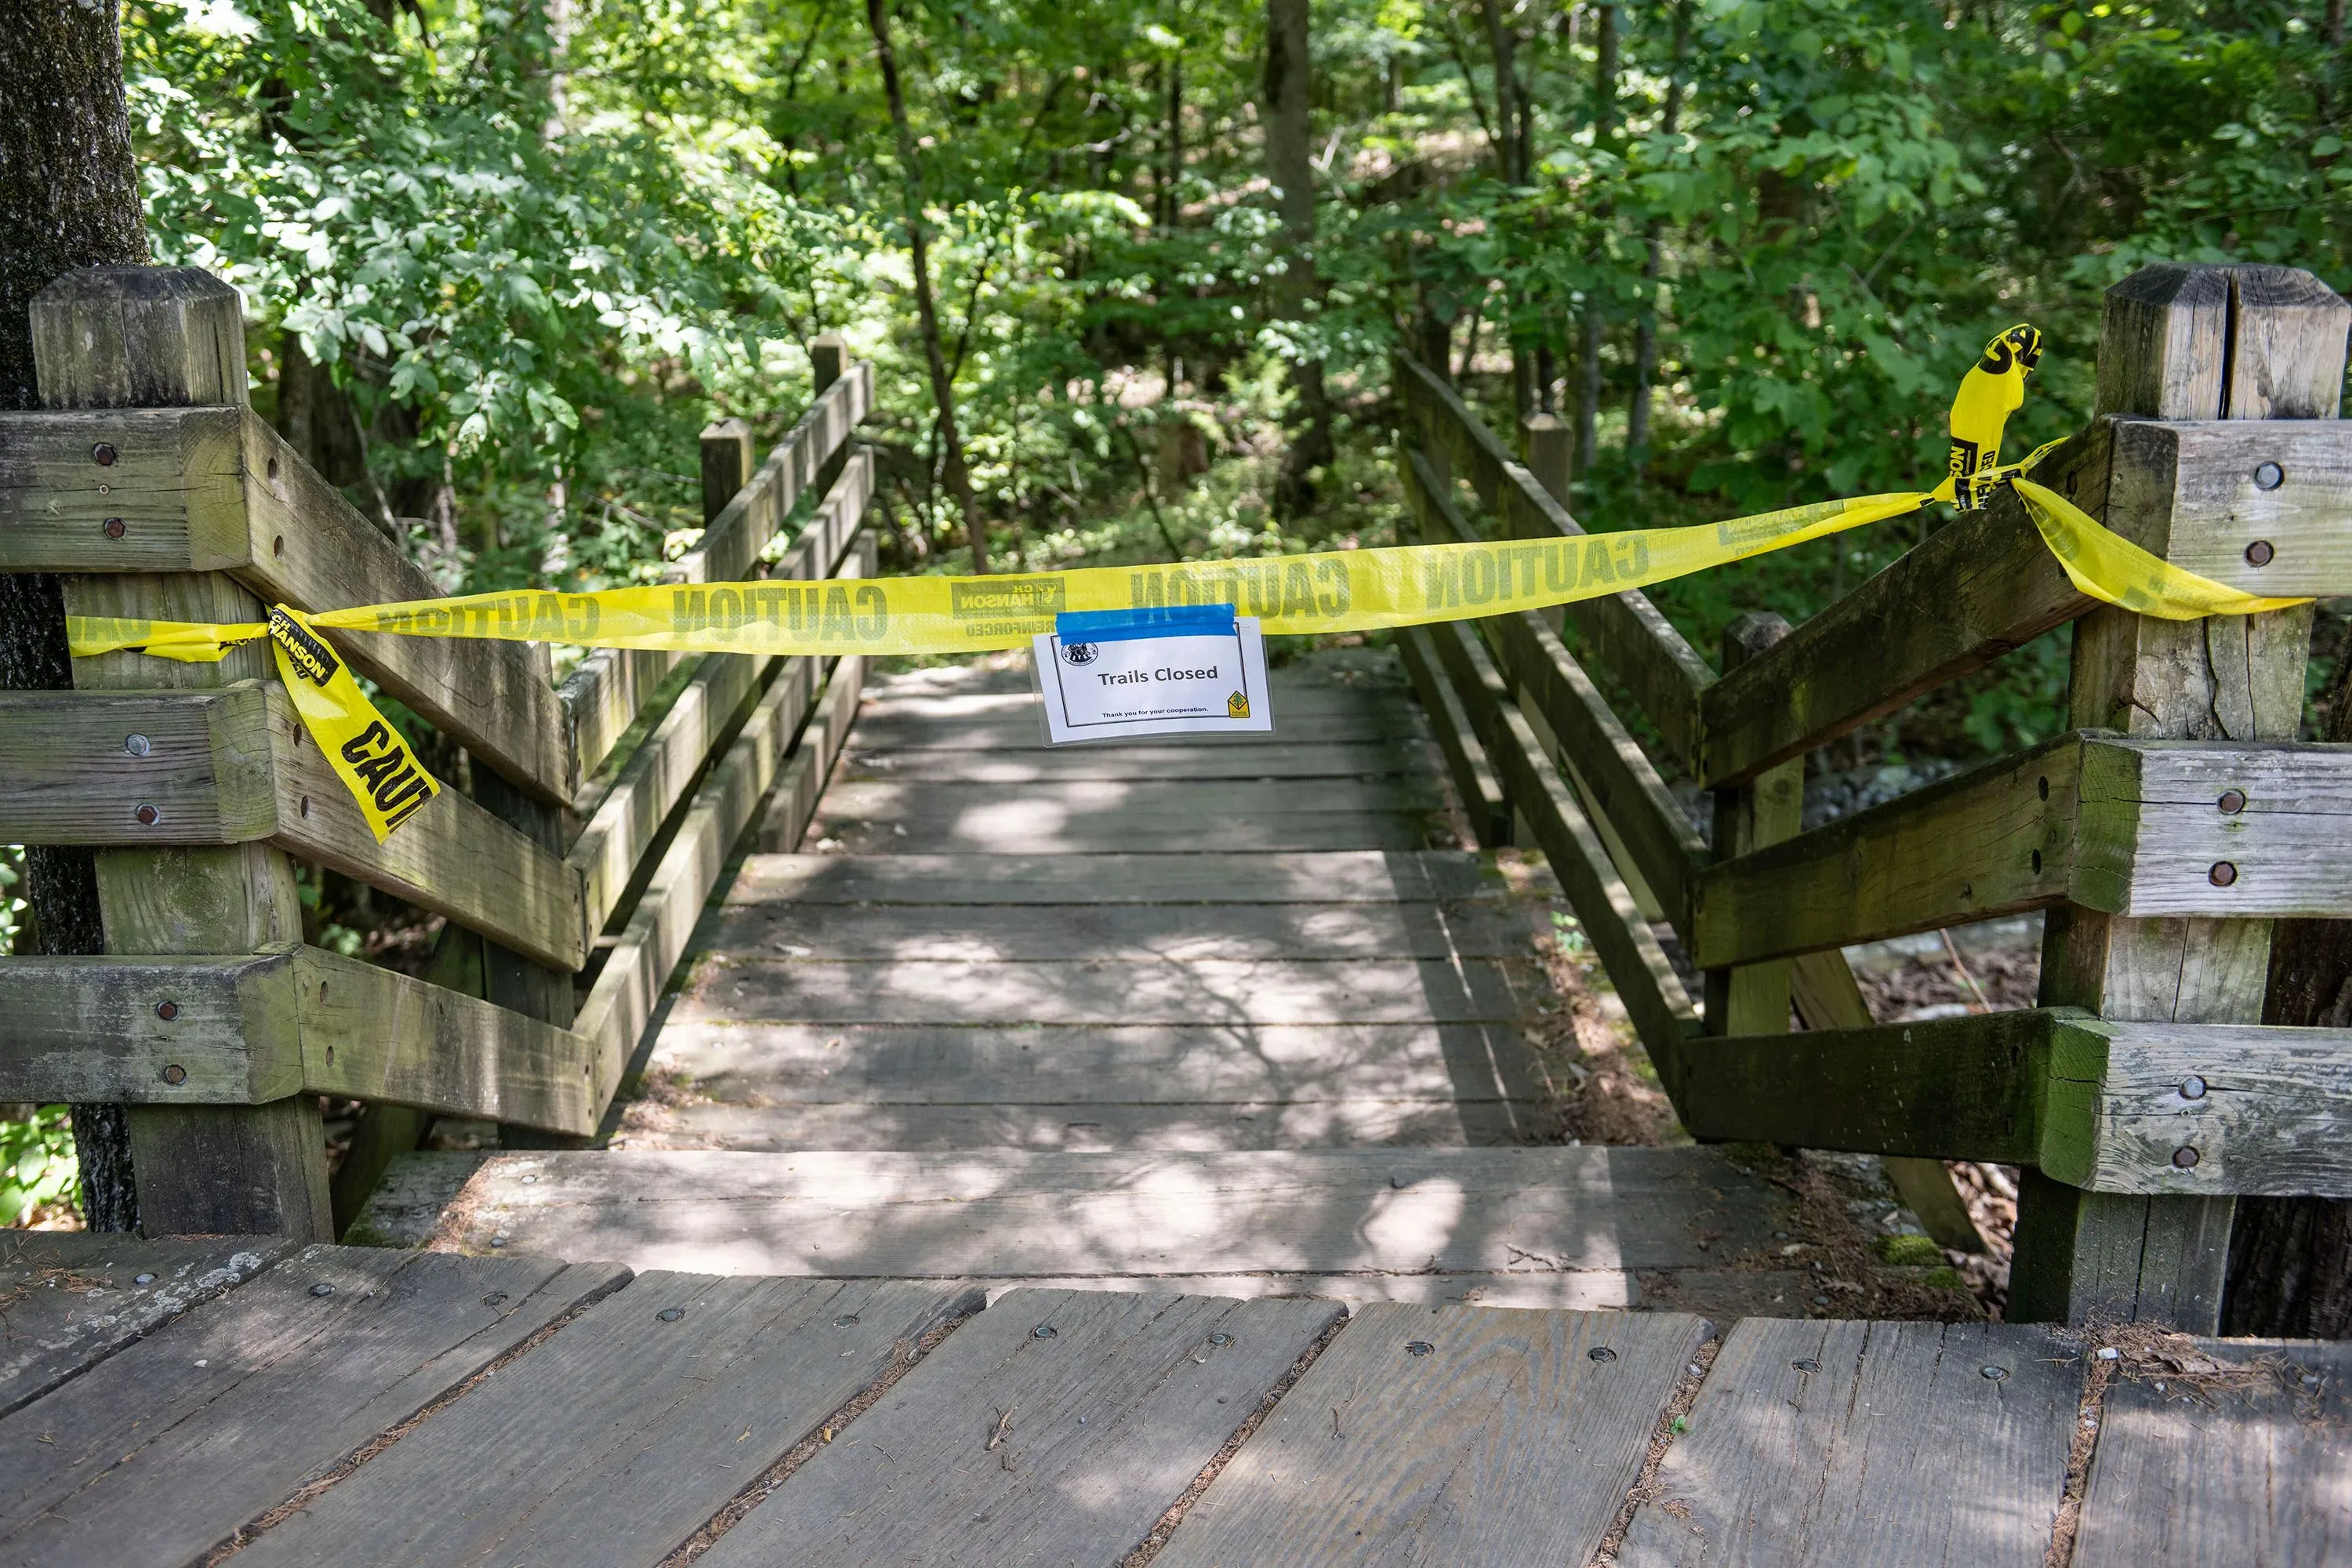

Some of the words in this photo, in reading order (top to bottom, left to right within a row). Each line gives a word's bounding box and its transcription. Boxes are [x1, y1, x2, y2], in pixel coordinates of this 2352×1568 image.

[268, 620, 326, 679] HANSON
[1097, 670, 1149, 686] Trails
[1154, 666, 1218, 681] Closed
